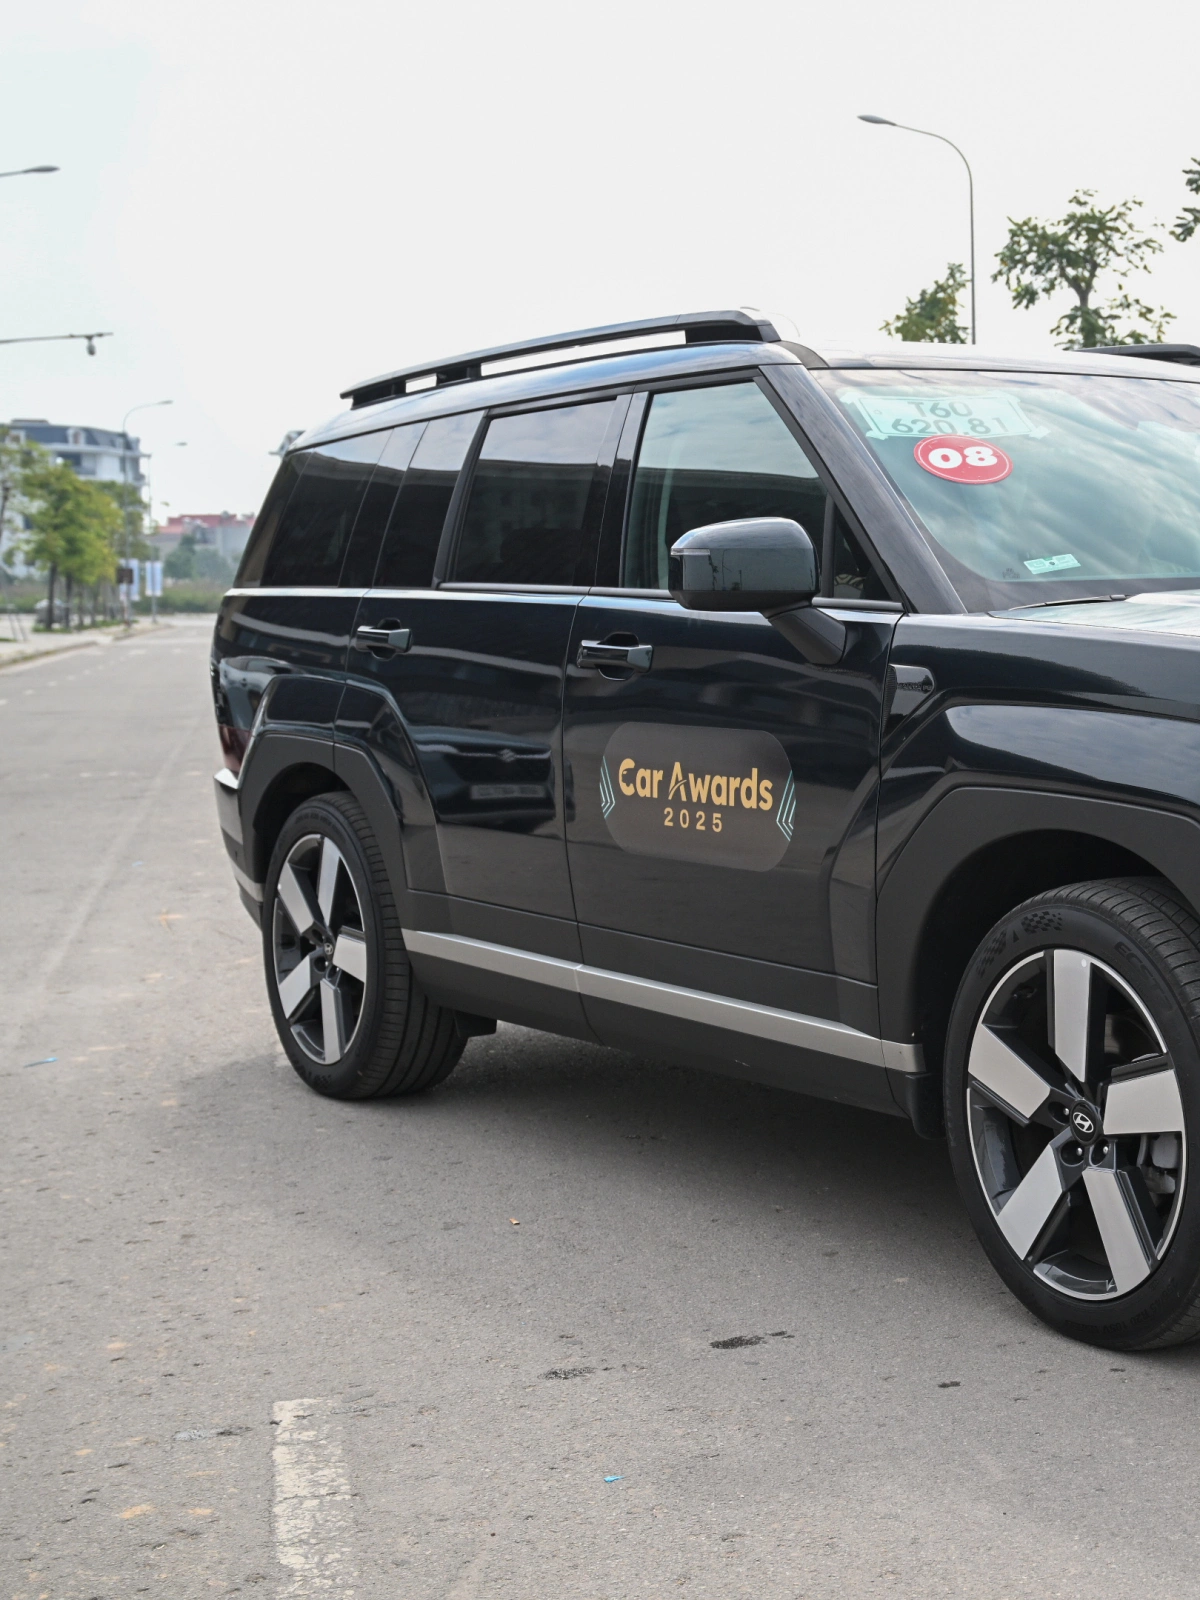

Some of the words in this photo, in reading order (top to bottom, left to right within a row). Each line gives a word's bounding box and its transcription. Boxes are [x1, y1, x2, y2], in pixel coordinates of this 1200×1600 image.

[907, 401, 973, 419] T60
[891, 417, 1009, 435] 620.81
[928, 446, 998, 469] 08
[618, 758, 663, 798] Car
[668, 762, 773, 810] Awards
[663, 807, 722, 832] 2025
